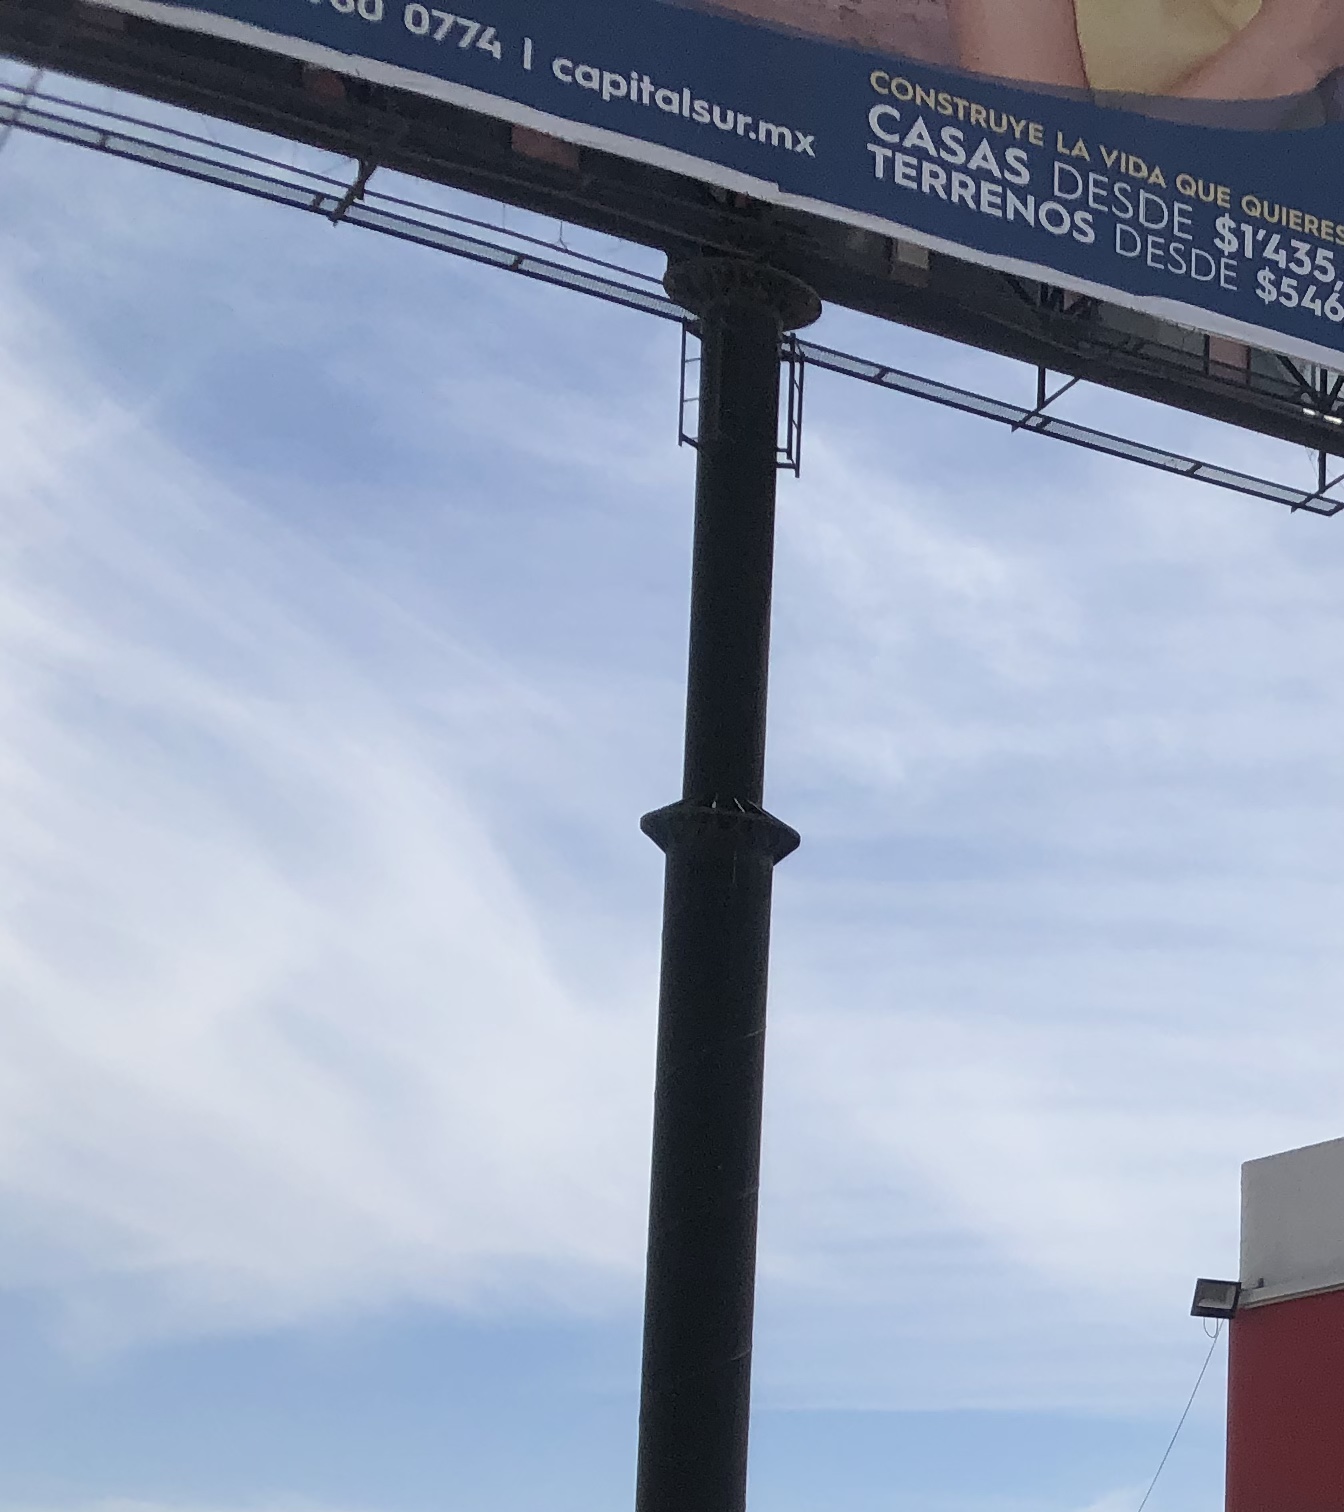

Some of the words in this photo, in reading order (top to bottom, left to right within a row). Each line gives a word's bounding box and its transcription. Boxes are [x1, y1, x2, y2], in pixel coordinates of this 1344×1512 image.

[404, 3, 502, 61] 0774
[552, 55, 816, 157] capitalsur.mx
[870, 70, 1044, 147] CONSTRUYE
[1056, 130, 1091, 161] LA
[1100, 144, 1166, 188] VIDA
[1176, 173, 1231, 208] QUE
[867, 142, 1096, 244] TERRENOS
[1115, 223, 1238, 290] DESDE
[868, 103, 1031, 185] CASAS
[1053, 160, 1193, 241] DESDE
